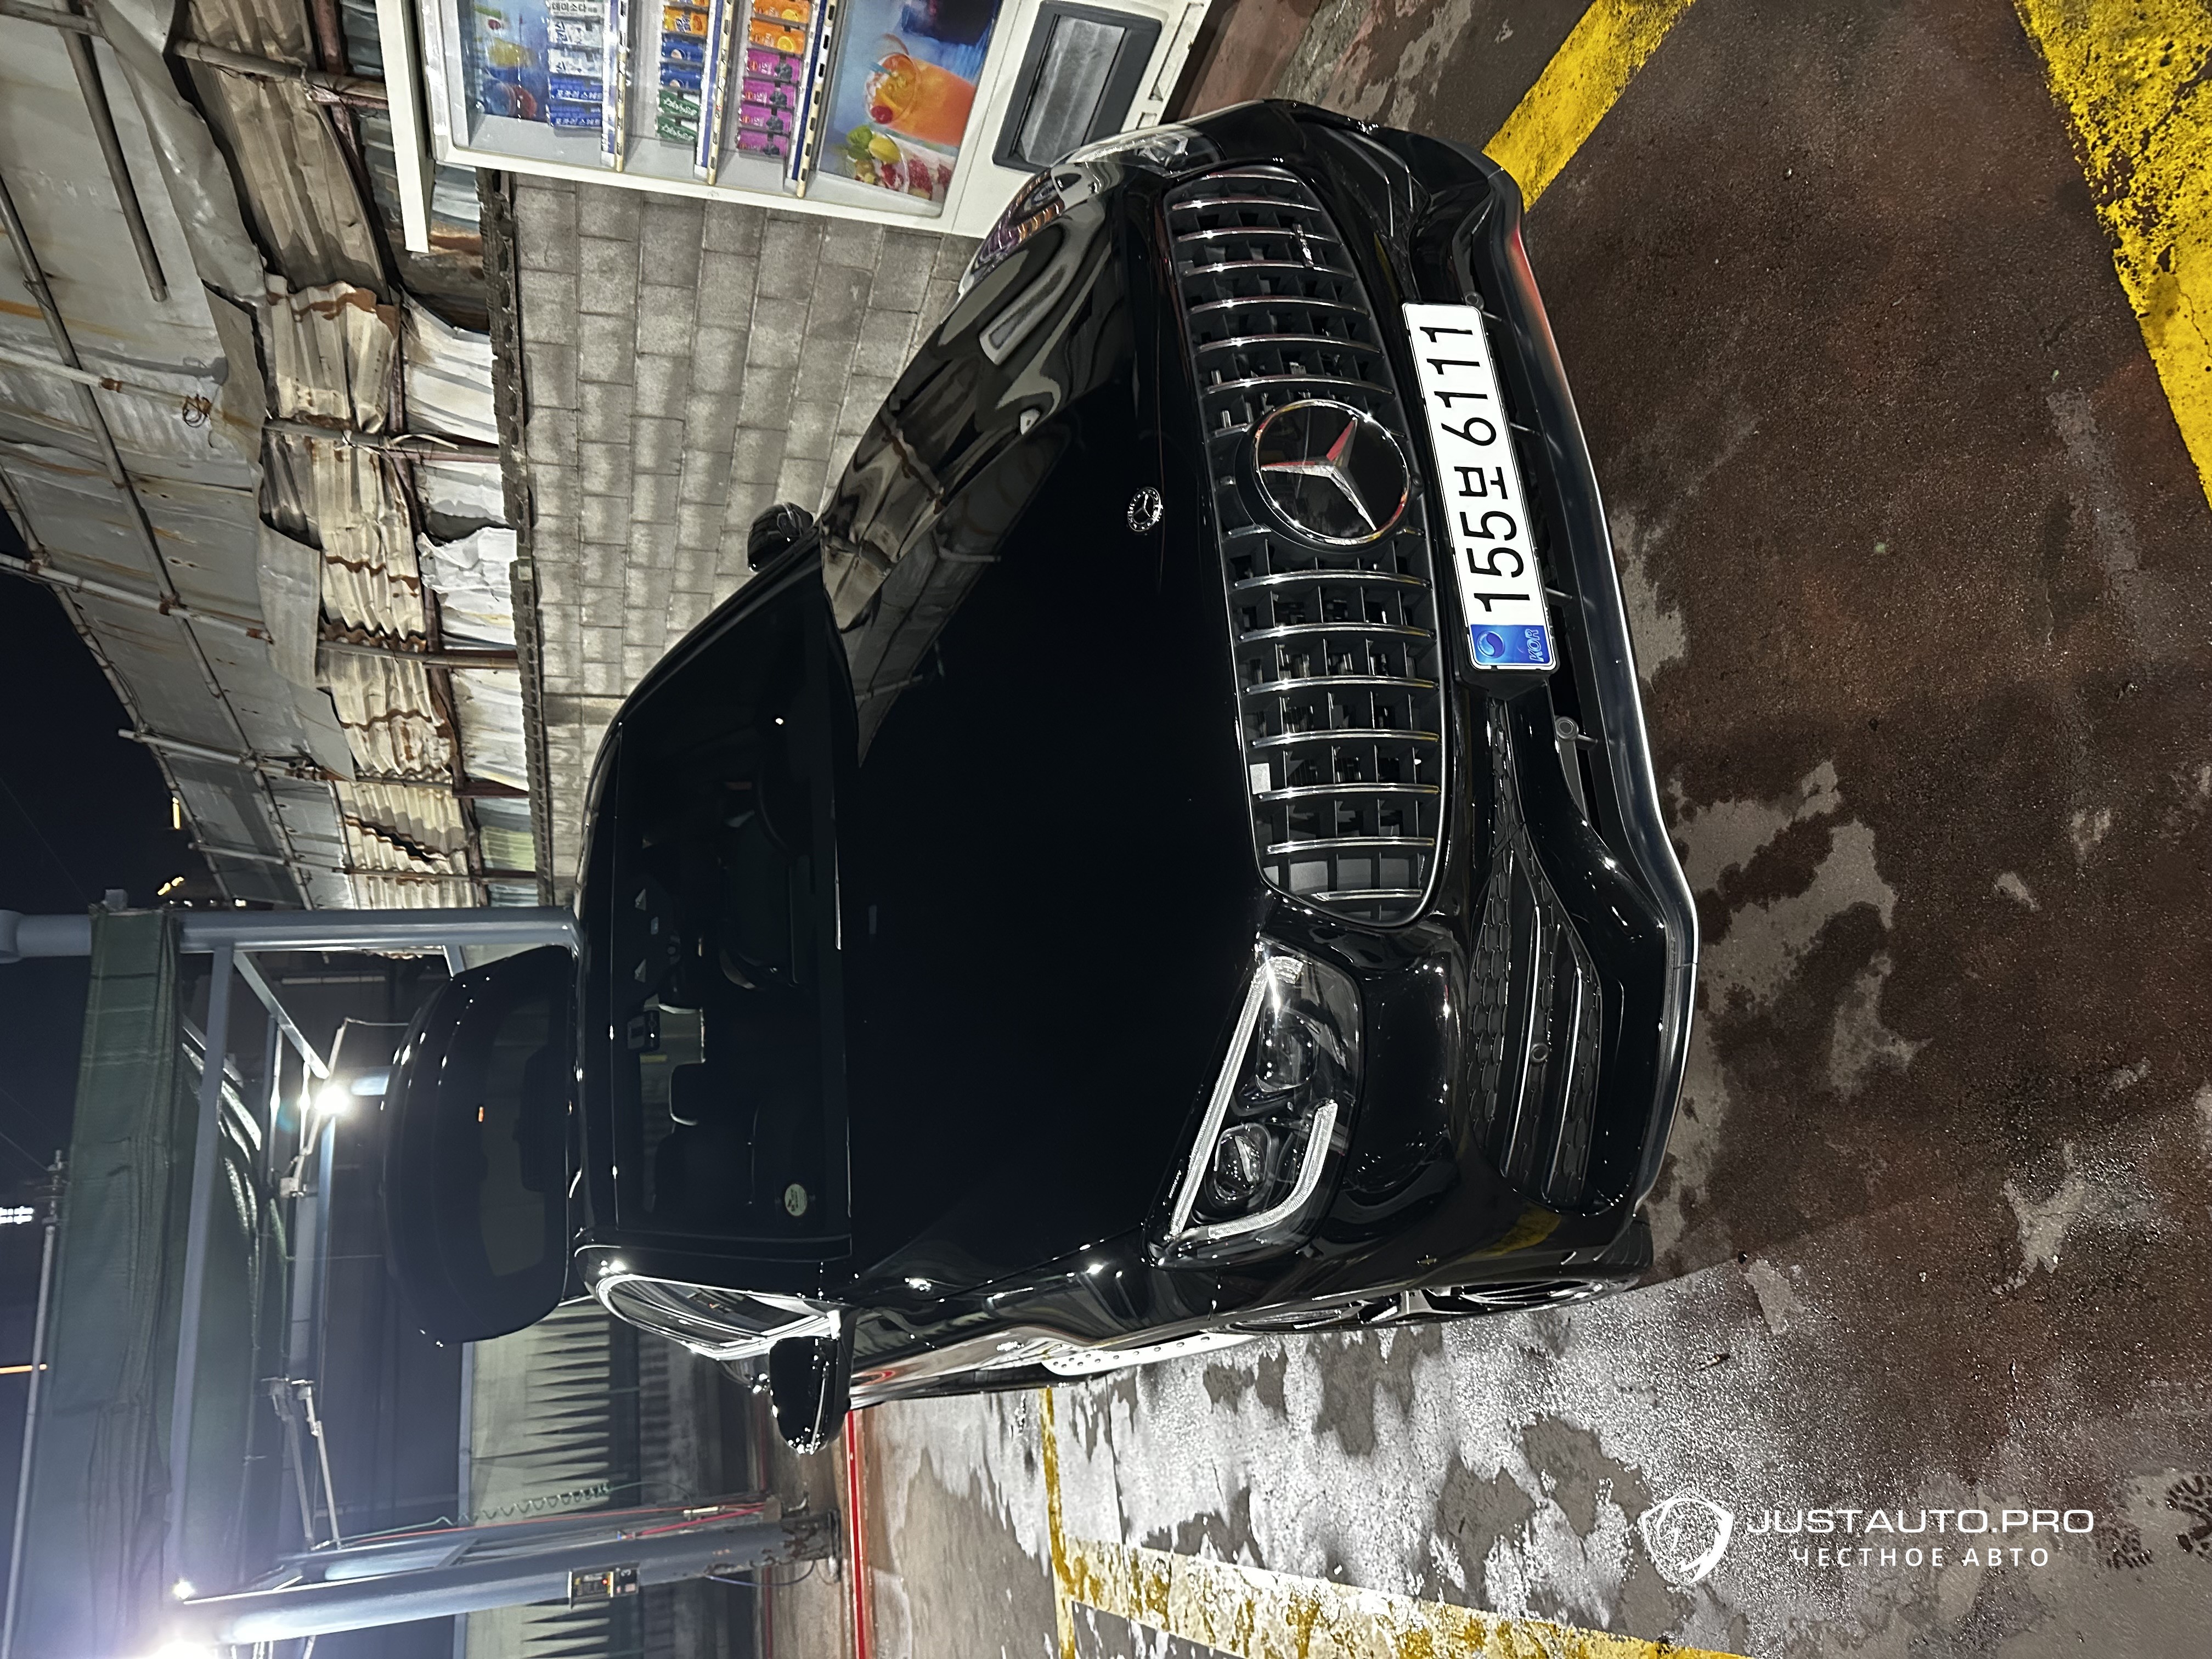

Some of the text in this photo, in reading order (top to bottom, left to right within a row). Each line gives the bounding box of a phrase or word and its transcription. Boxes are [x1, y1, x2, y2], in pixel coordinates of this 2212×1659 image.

[1420, 326, 1530, 612] 155보 6111
[1525, 628, 1544, 662] KOR
[620, 1568, 631, 1577] 3
